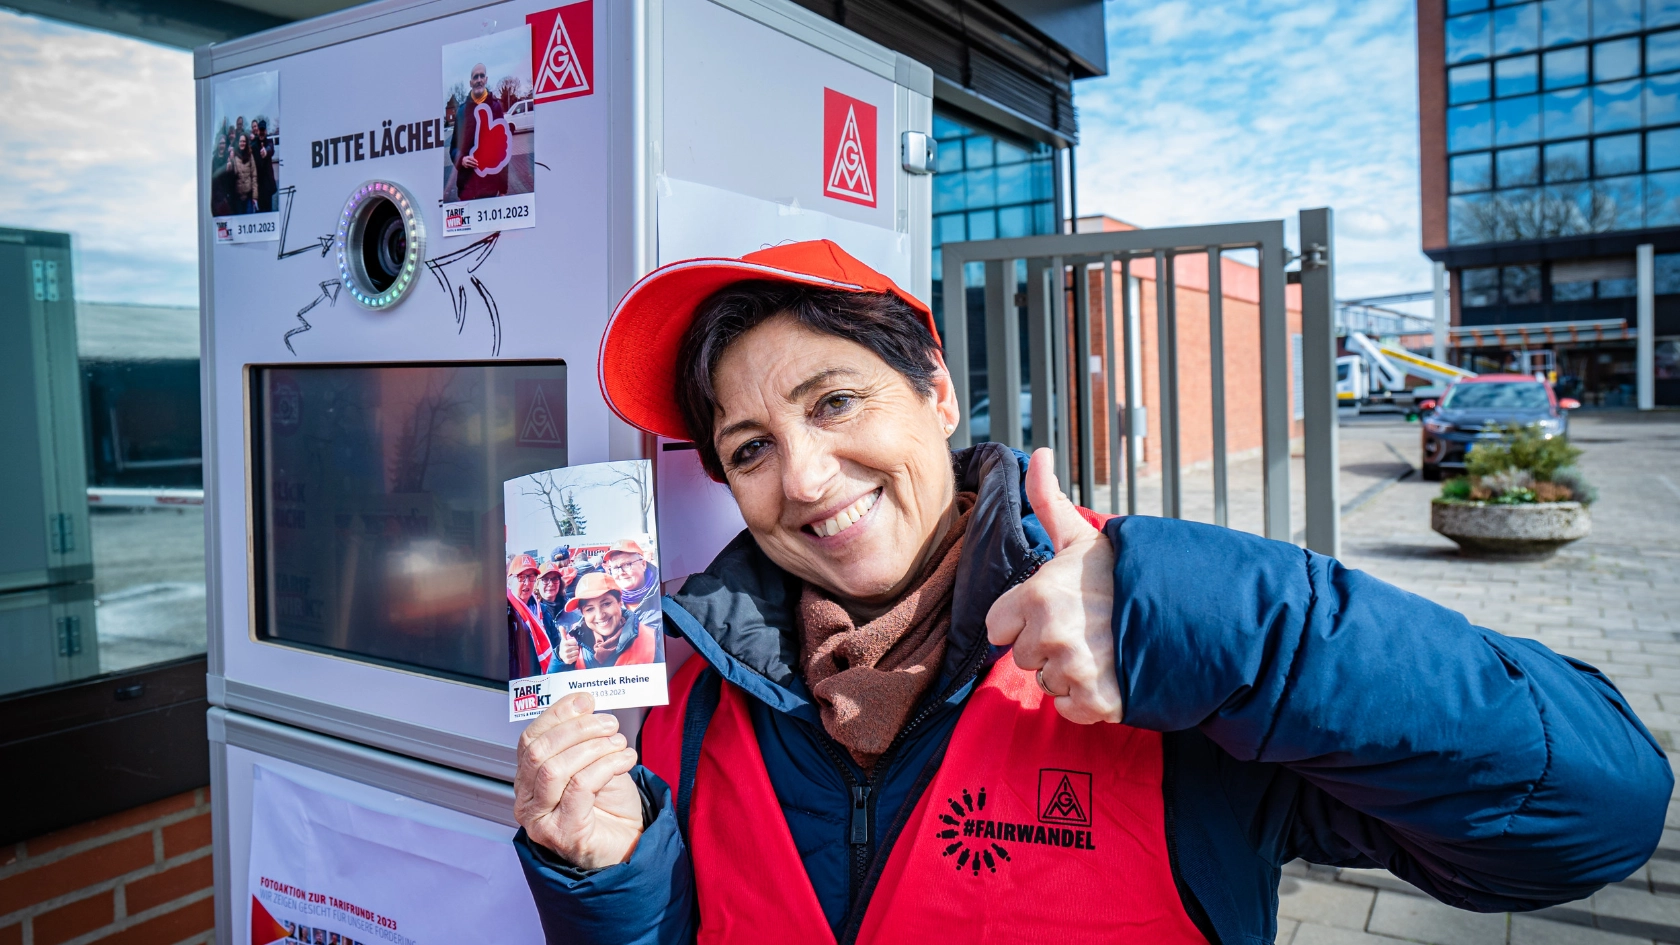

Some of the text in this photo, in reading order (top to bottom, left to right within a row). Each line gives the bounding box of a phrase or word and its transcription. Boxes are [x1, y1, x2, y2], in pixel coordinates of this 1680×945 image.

[311, 119, 445, 169] BITTE LÄCHEL
[446, 207, 465, 218] TARIF
[477, 205, 529, 222] 31.01.2023
[238, 222, 276, 235] 31.01.2023
[513, 683, 542, 699] TARIF
[568, 675, 650, 690] Warnstreik Rheine
[514, 694, 552, 712] WIRKT
[963, 818, 1096, 851] #FAIRWANDEL
[260, 876, 397, 931] FOTOAKTION ZUR TARIFRUNDE 2023
[260, 888, 273, 903] WIR
[273, 893, 297, 911] ZEIGEN
[298, 901, 331, 919] GESICHT
[332, 907, 347, 923] FÜR
[348, 914, 374, 935] UNSERE
